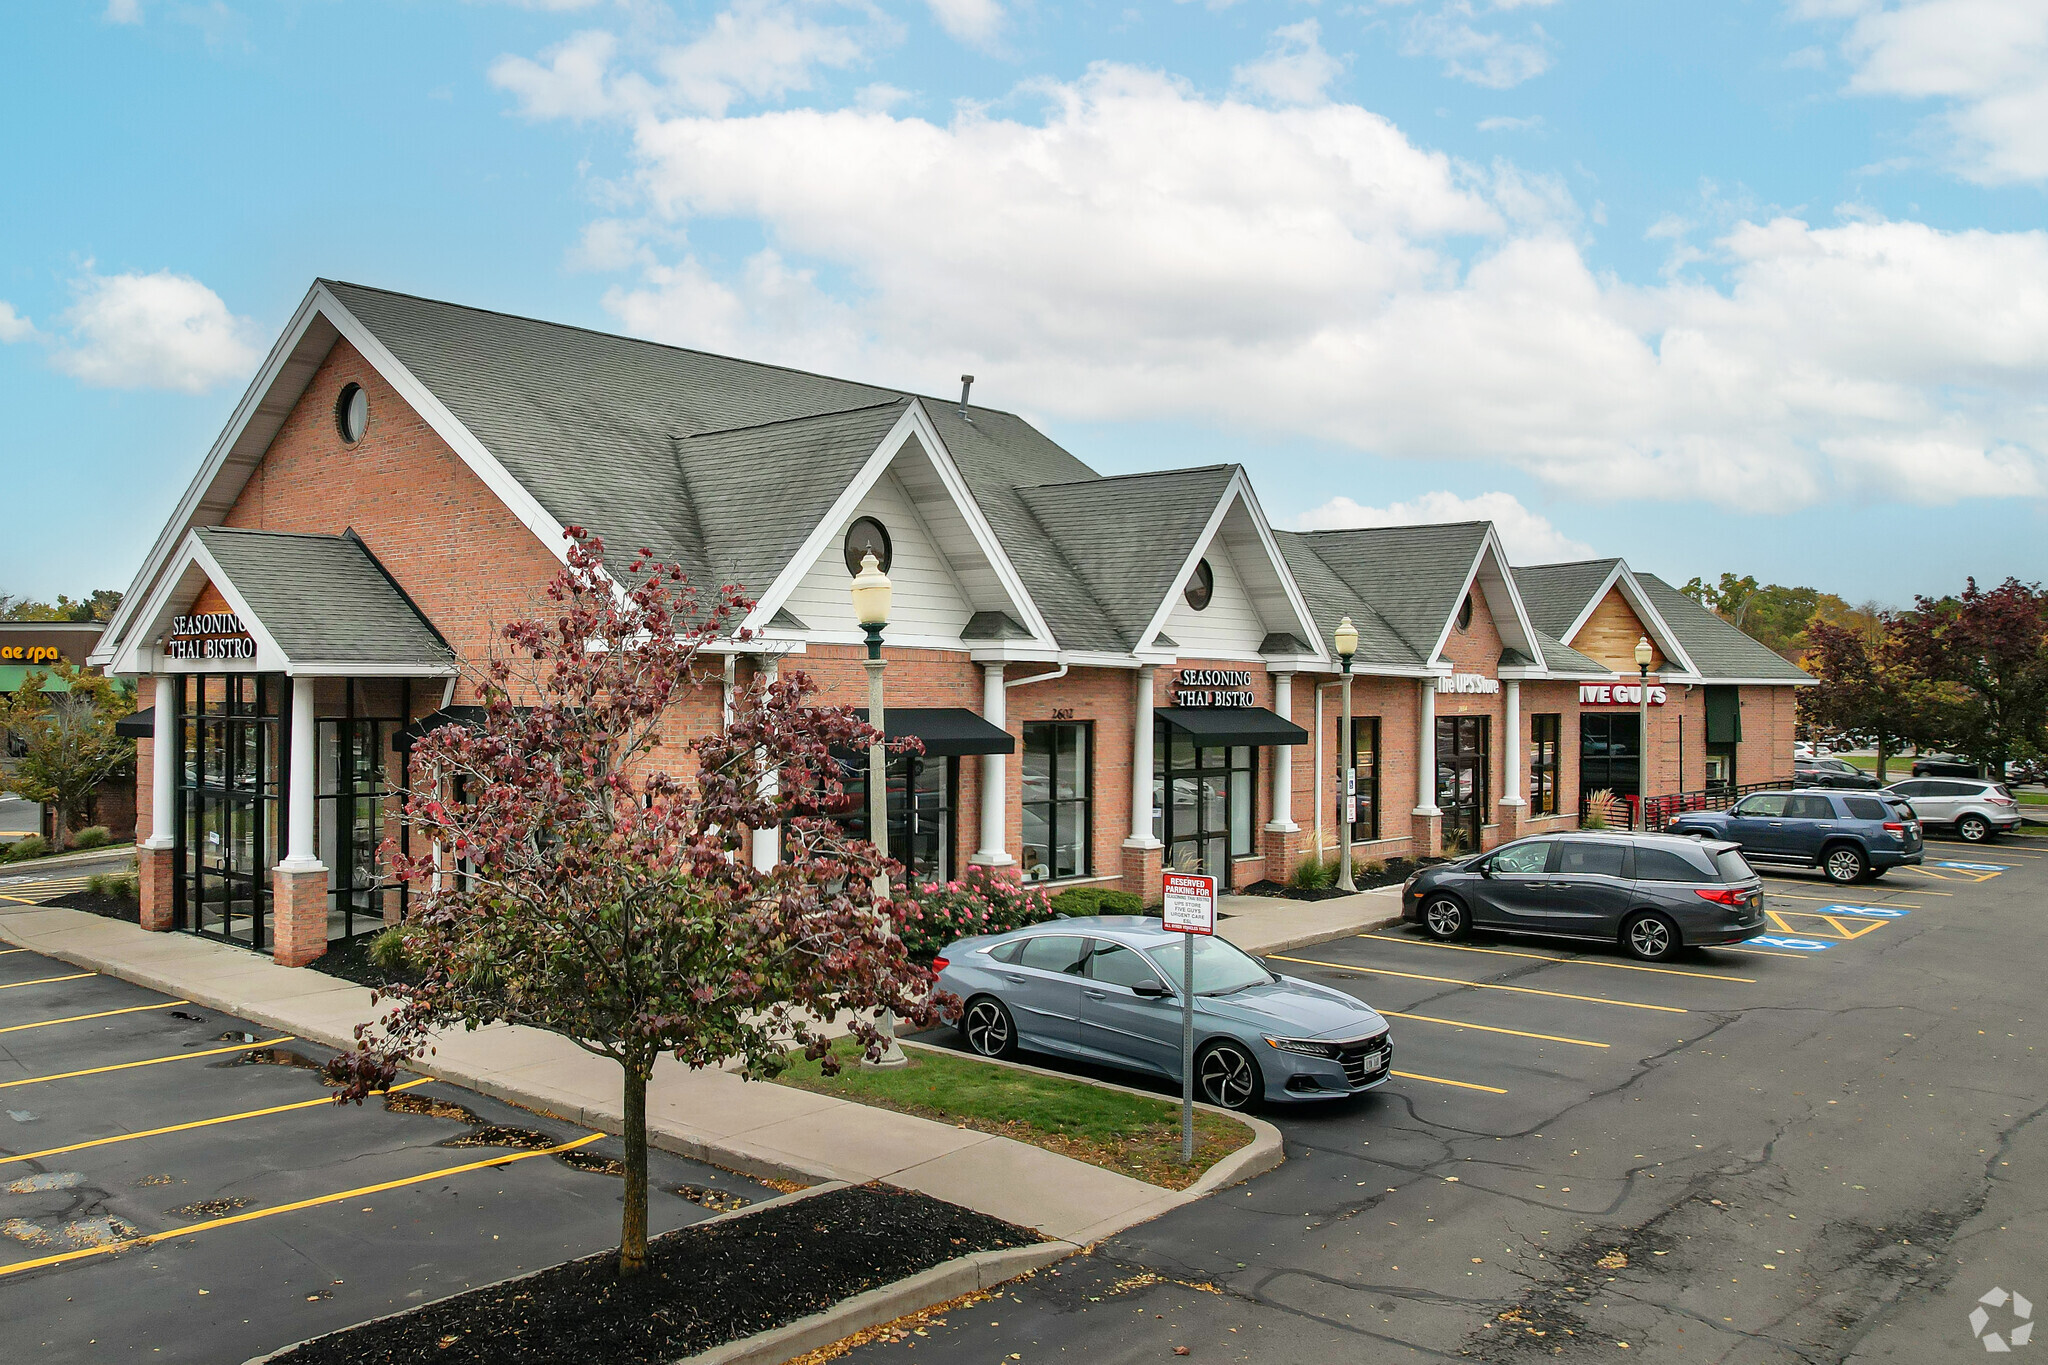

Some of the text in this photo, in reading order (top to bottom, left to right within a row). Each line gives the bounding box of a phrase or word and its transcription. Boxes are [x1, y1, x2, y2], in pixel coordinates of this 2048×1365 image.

[26, 646, 58, 664] spa
[169, 638, 253, 659] THAI BISTRO
[1183, 669, 1251, 686] SEASONING
[1456, 674, 1474, 694] UPS
[1178, 690, 1255, 706] THAI BISTRO
[1580, 686, 1610, 702] IVE
[1166, 886, 1210, 896] PARKING FOR
[1170, 878, 1205, 888] RESERVED
